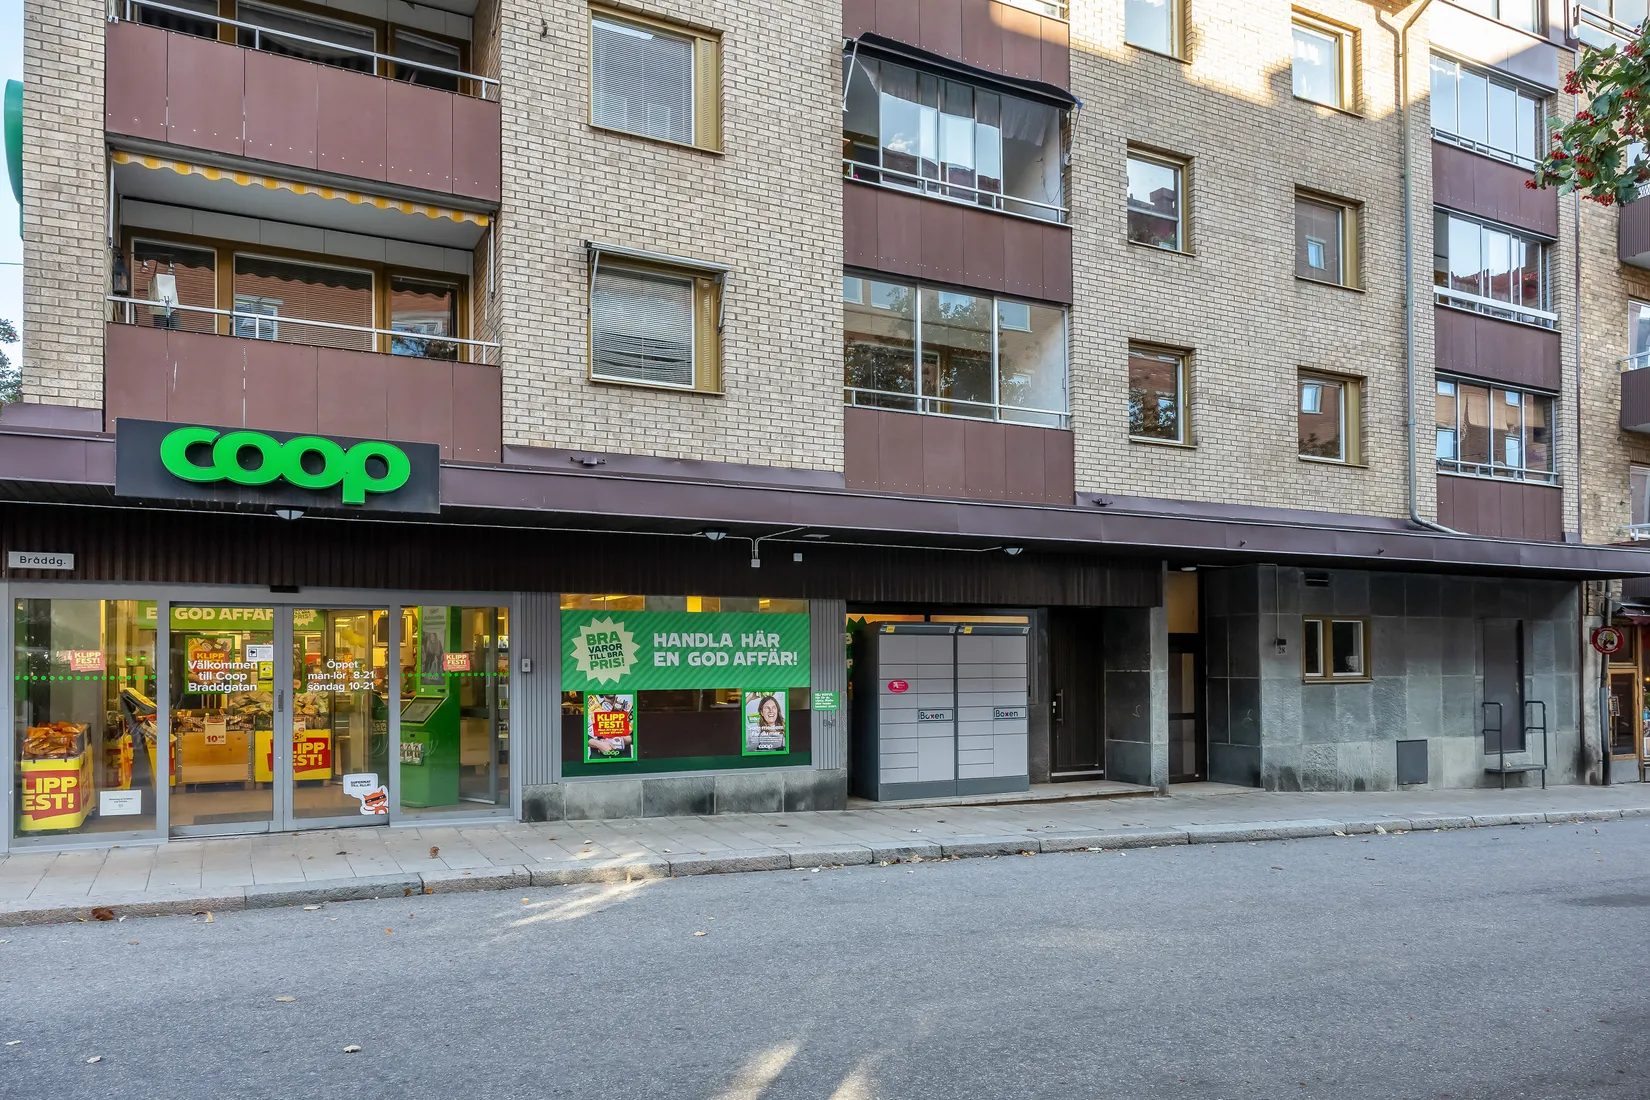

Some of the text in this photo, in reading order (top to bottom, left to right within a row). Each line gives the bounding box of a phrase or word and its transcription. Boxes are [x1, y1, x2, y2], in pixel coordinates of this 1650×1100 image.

[160, 427, 411, 504] coop
[19, 555, 67, 567] Bråddg.
[145, 606, 158, 620] E
[174, 607, 216, 620] GOD
[586, 631, 621, 646] BRA
[653, 629, 780, 648] HANDLA HÄR
[588, 643, 623, 653] VAROR
[1278, 646, 1286, 654] 28
[196, 652, 225, 660] KLIPP
[653, 648, 798, 667] EN GOD AFFÄR!
[187, 660, 258, 670] Välkommen
[326, 659, 359, 670] Öppet
[590, 657, 625, 671] PRIS!
[198, 671, 248, 682] till Coop
[307, 671, 376, 680] mån-lör 8-21
[187, 682, 258, 694] Bråddgatan
[307, 682, 375, 693] söndag 10-21
[598, 721, 624, 729] FEST!
